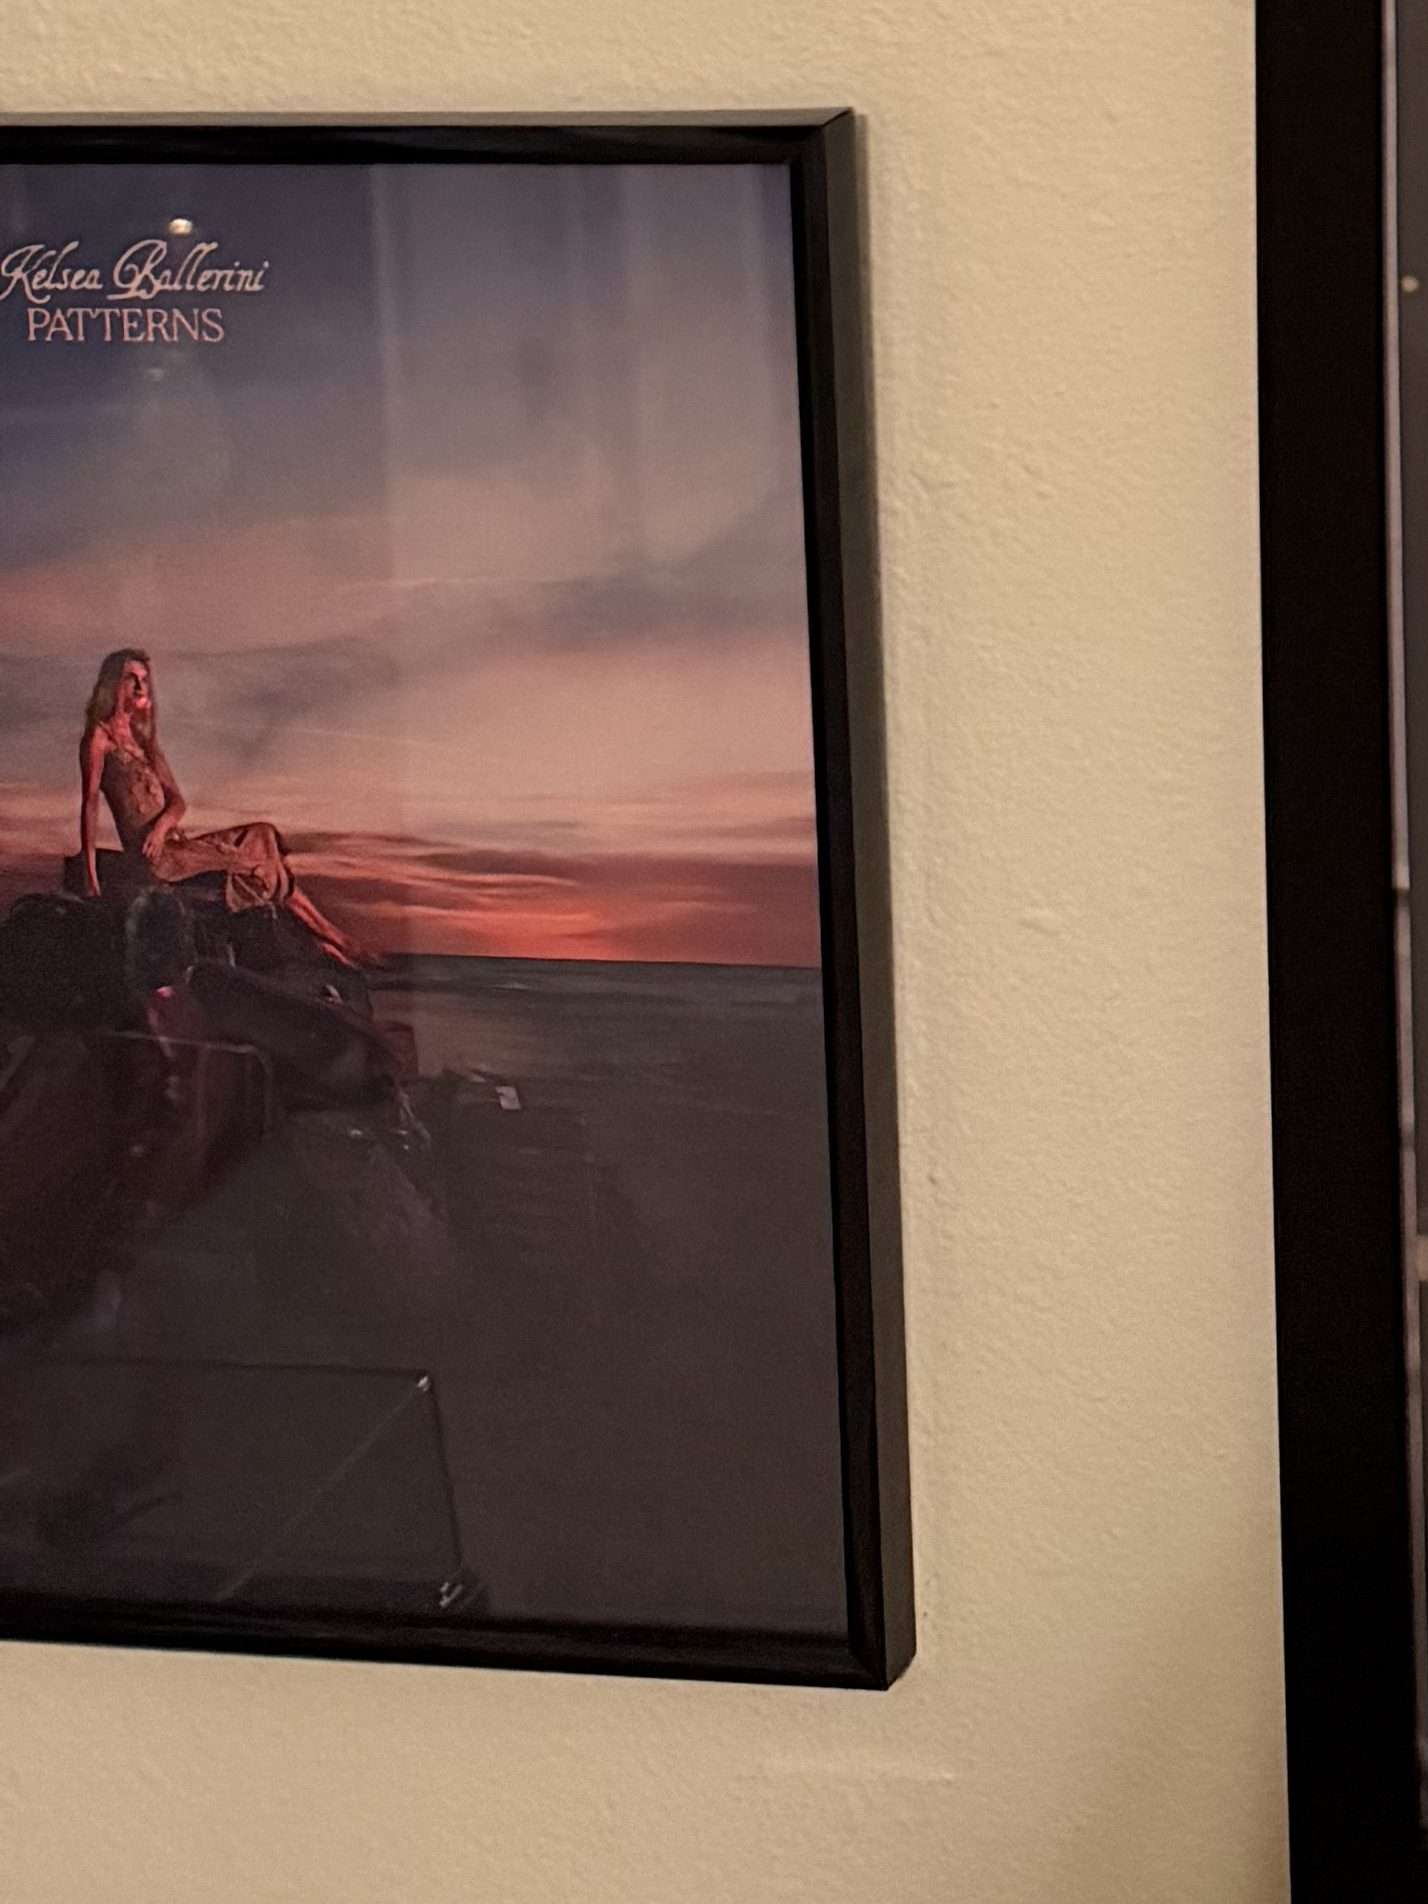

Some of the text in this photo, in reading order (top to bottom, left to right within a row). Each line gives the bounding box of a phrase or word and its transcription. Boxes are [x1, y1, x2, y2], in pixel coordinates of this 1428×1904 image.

[0, 239, 269, 304] Kelsea Ballerini
[27, 307, 225, 343] PATTERNS
